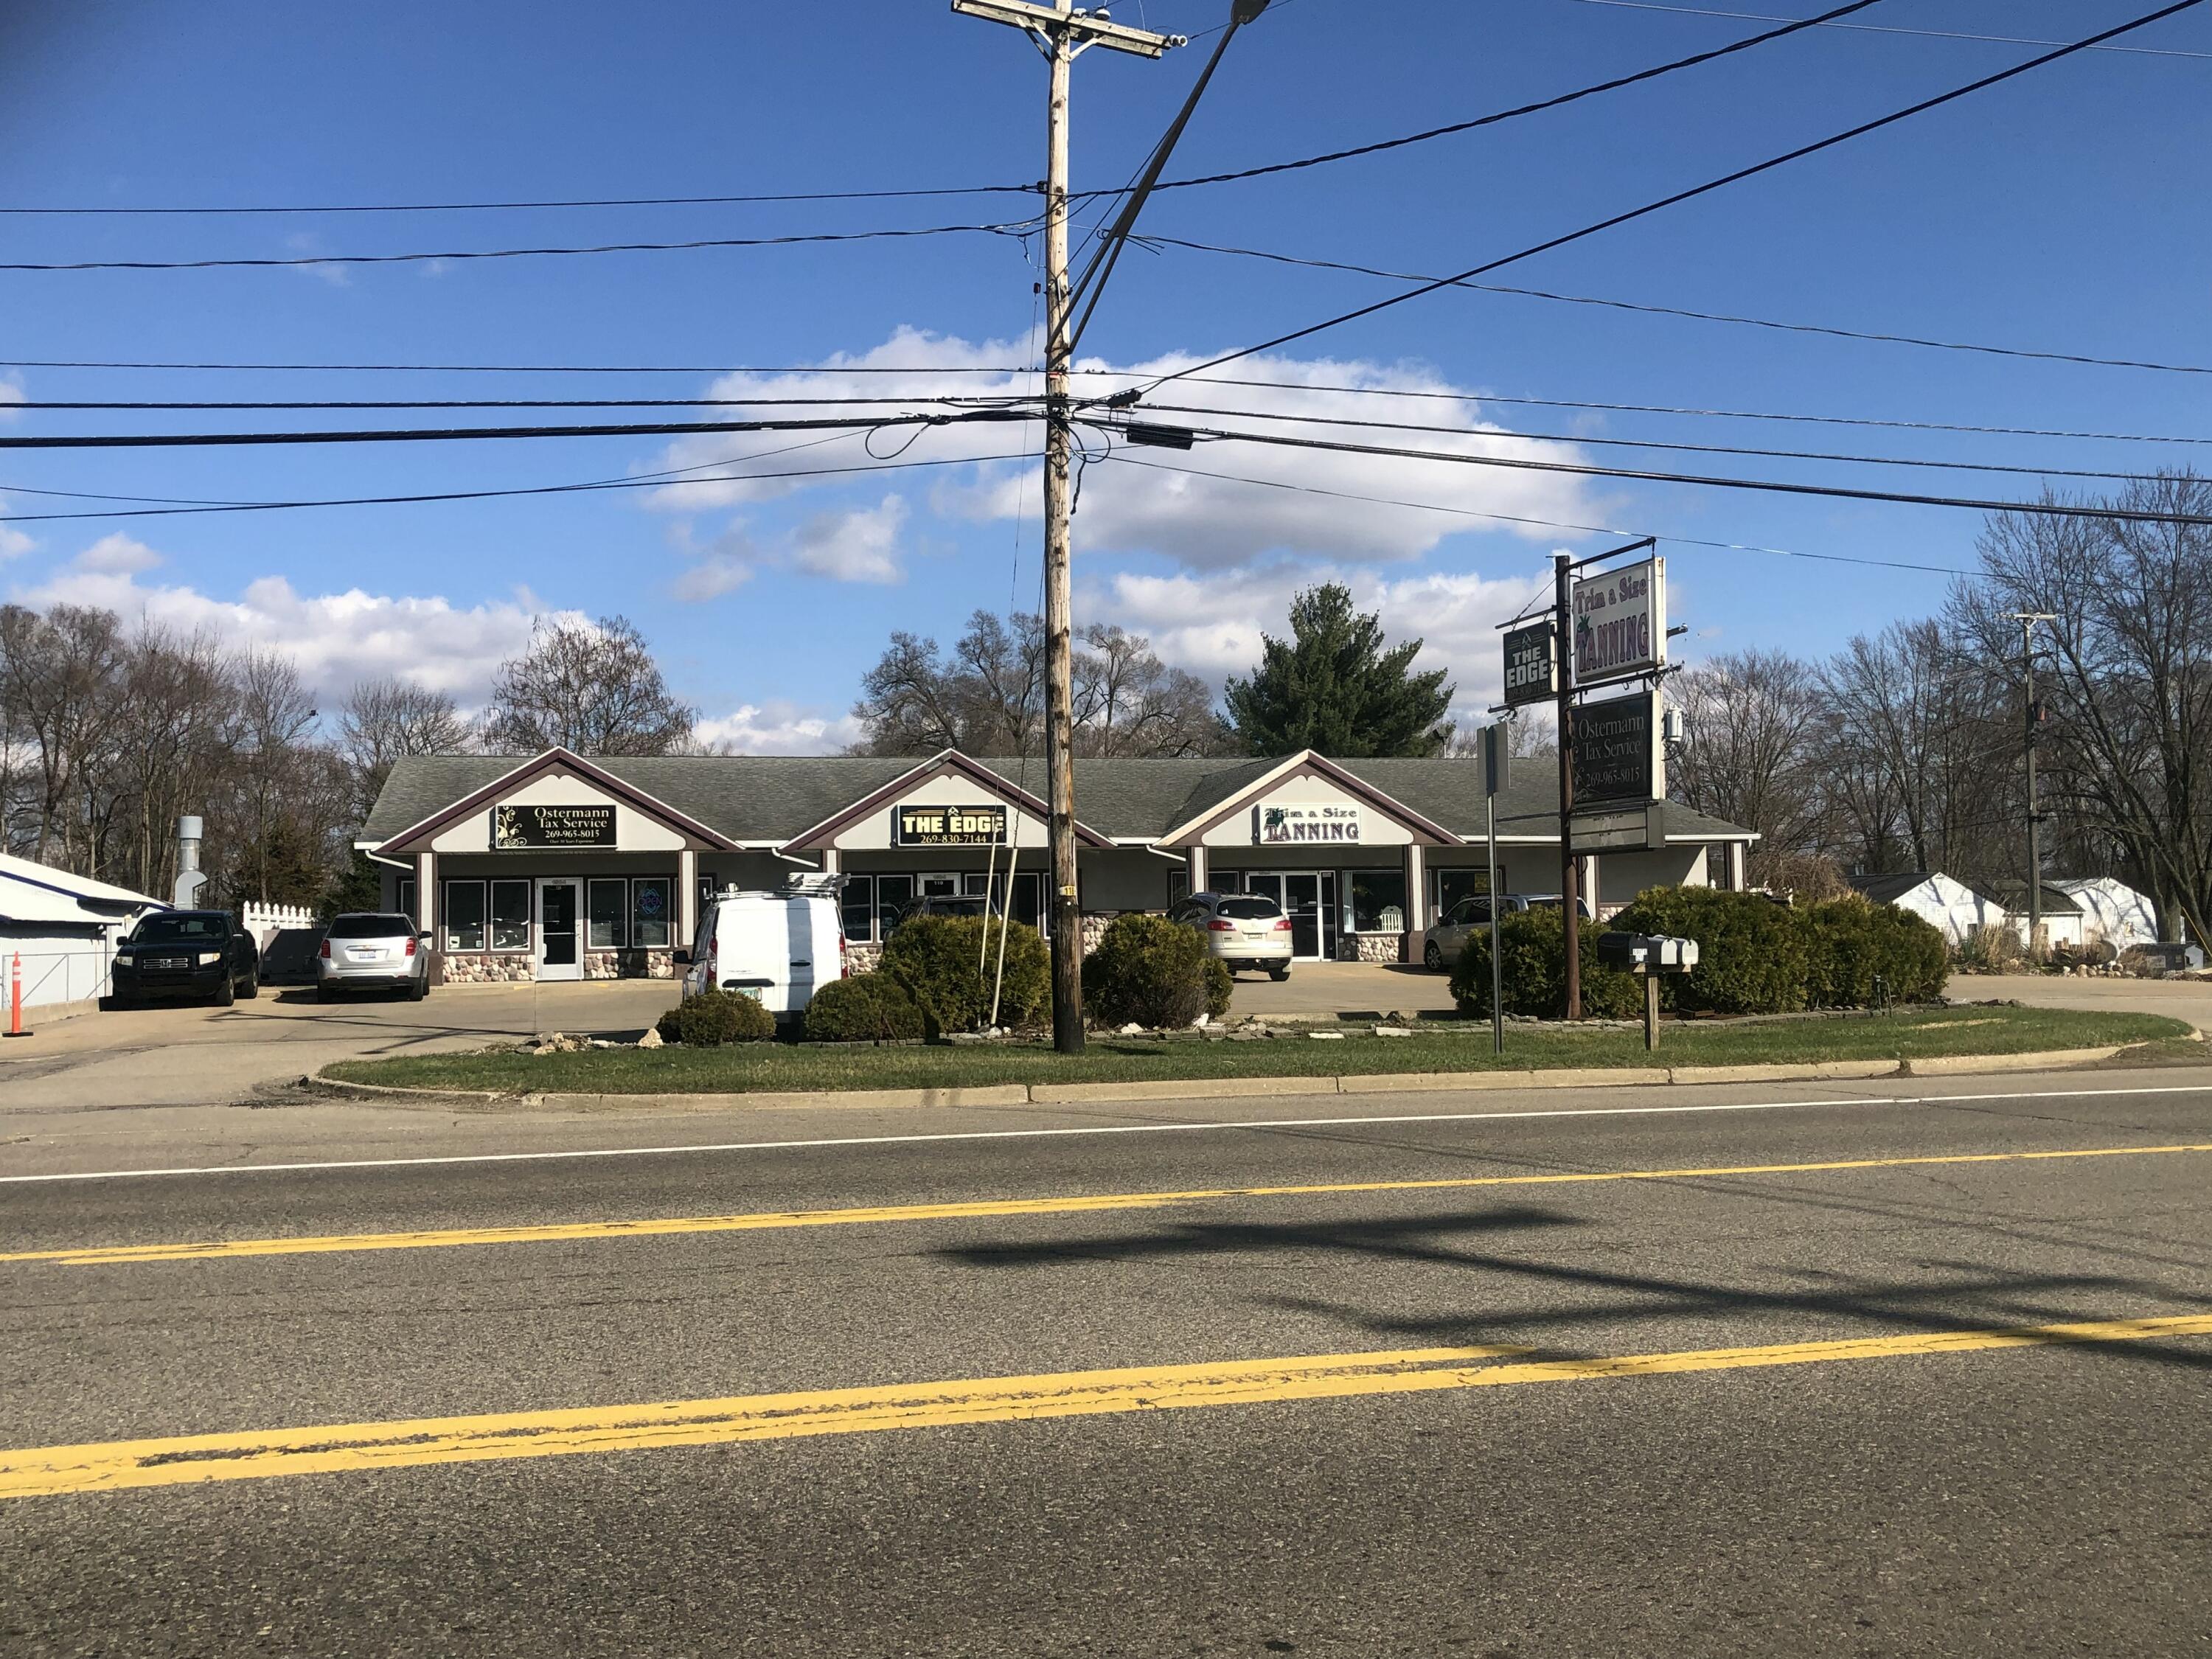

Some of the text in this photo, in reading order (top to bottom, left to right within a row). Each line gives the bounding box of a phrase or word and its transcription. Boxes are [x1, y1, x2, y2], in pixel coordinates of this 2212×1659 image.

[1576, 576, 1647, 614] Trim a Size
[1576, 611, 1649, 672] TANNING
[1512, 646, 1541, 666] THE
[1506, 658, 1548, 689] EDGE
[1579, 716, 1644, 740] Ostermann
[1582, 738, 1641, 761] Tax Service
[1586, 767, 1640, 787] 269-965-8015
[534, 807, 609, 818] Ostermann
[1265, 807, 1304, 818] Trim
[1322, 807, 1357, 818] Size
[537, 818, 608, 828] Tax Service
[902, 816, 1004, 833] THE EDGE
[1263, 822, 1359, 841] TANNING
[545, 830, 599, 838] 269-965-8015
[920, 835, 987, 844] 269-830-7144
[637, 897, 662, 906] OPEN
